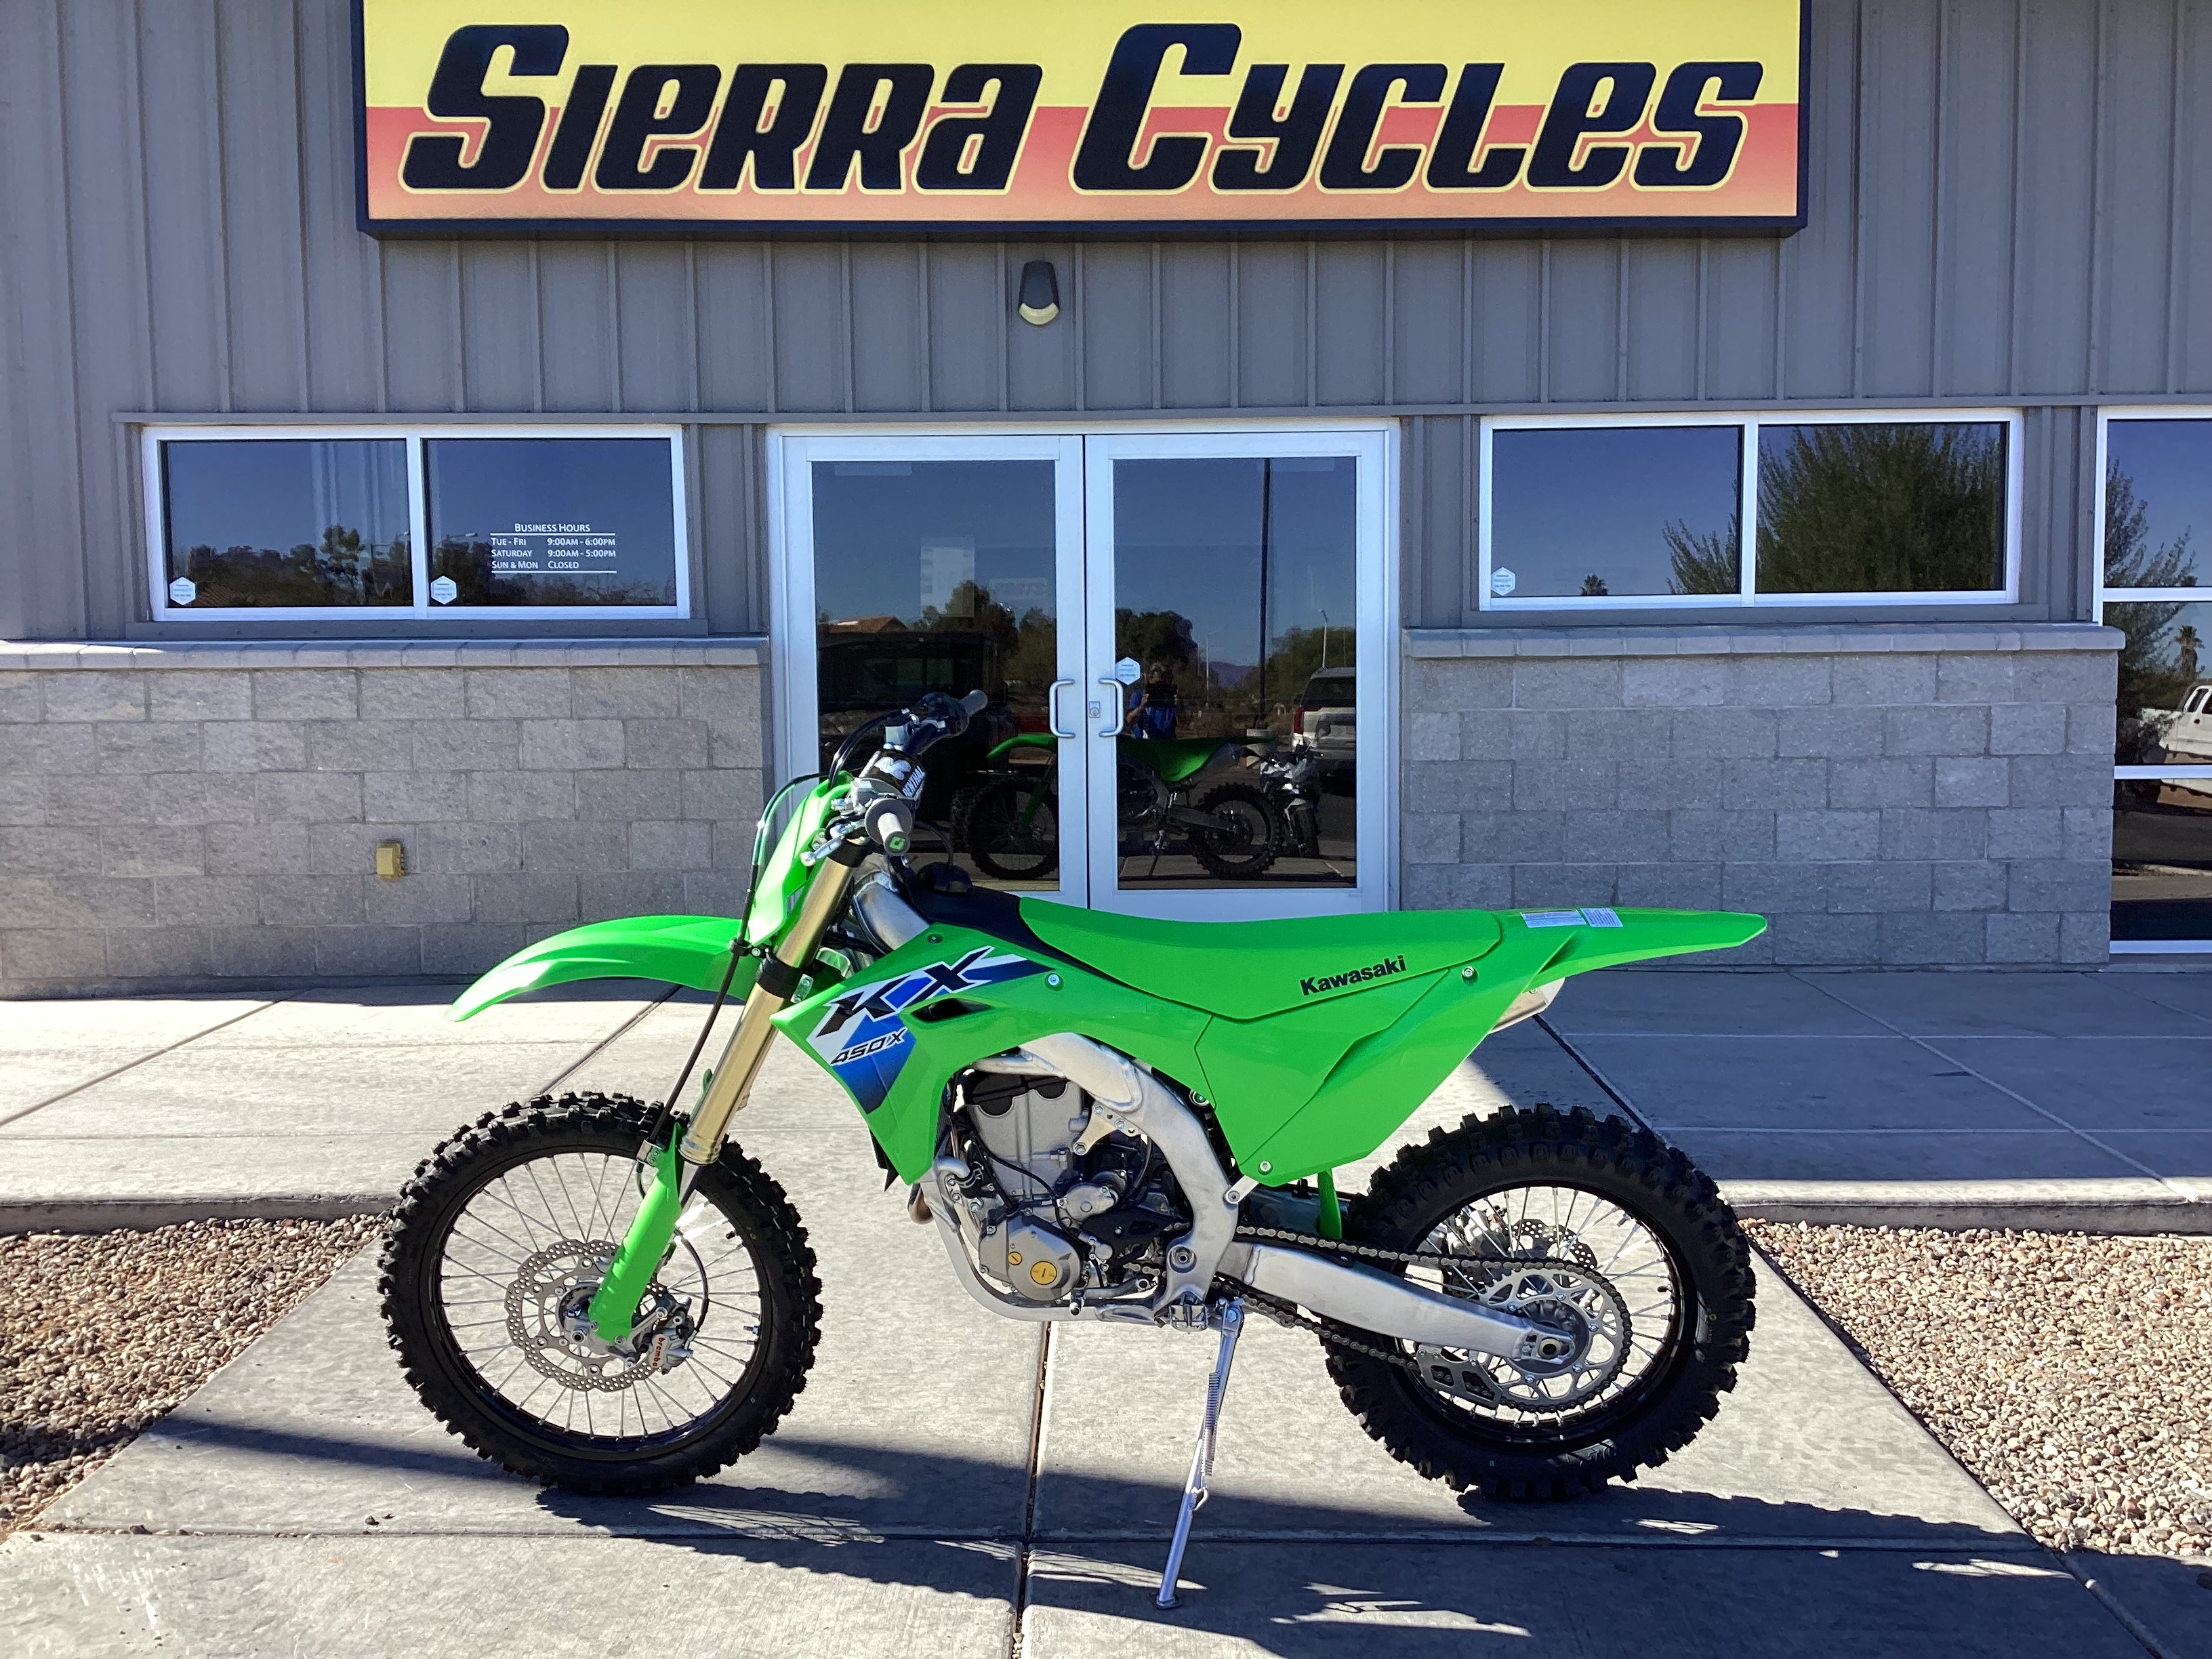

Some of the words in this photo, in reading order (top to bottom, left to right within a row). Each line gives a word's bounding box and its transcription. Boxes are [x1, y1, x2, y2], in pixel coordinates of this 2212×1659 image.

[514, 523, 557, 532] BUSINESS
[558, 523, 590, 532] HOURS
[491, 537, 507, 546] TUE
[514, 537, 526, 546] FRI
[547, 537, 578, 546] 9:00AM
[585, 537, 615, 546] 6:00PM
[1300, 955, 1406, 996] Kawasaki
[815, 946, 994, 1038] KX
